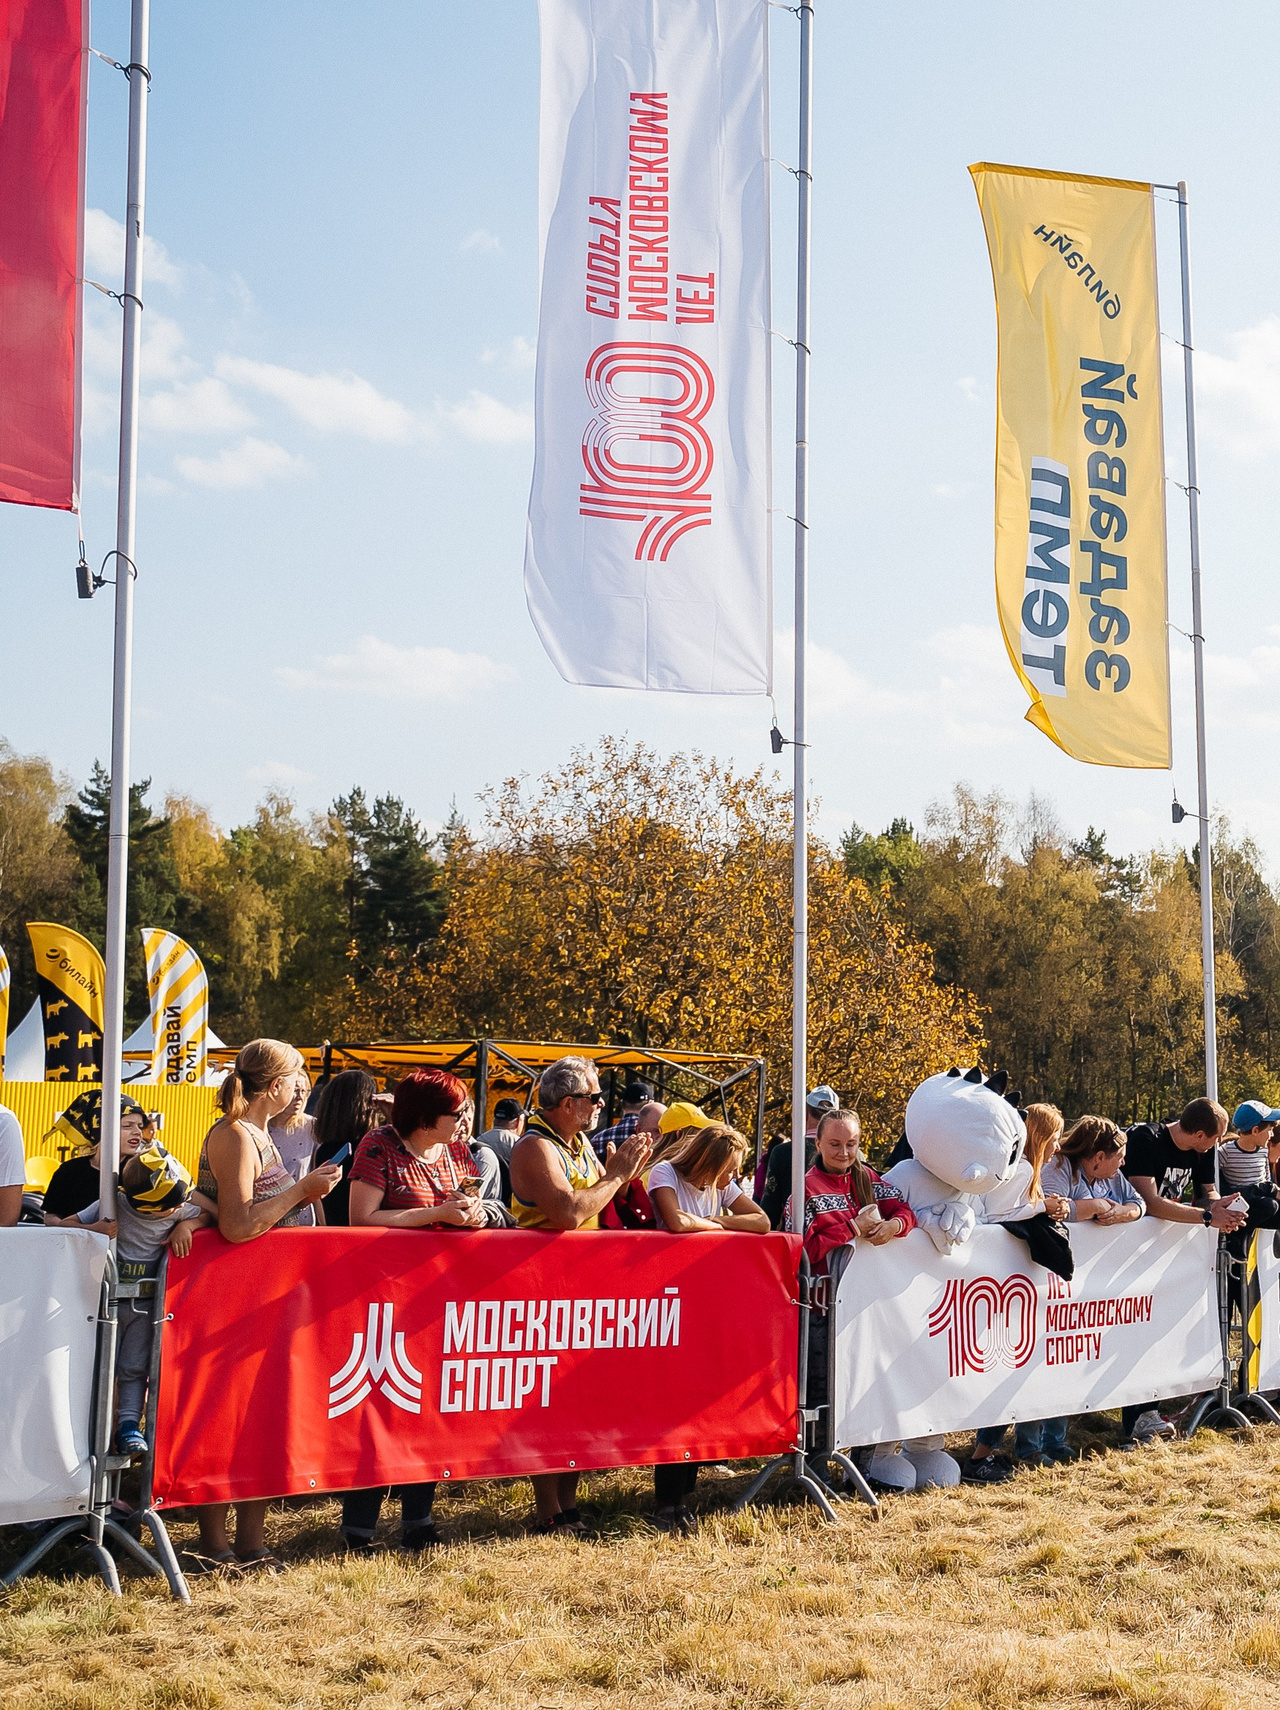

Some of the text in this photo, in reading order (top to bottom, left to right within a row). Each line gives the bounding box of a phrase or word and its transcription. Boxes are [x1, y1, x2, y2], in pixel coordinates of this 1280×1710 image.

[59, 957, 99, 999] билайн
[163, 1005, 184, 1084] адавай
[185, 1040, 198, 1084] емп
[442, 1287, 681, 1354] МОСКОВСКИЙ
[1045, 1295, 1154, 1333] МОСКОВСКОМУ
[1046, 1333, 1102, 1366] СПОРТУ
[439, 1356, 558, 1414] СПОРТ
